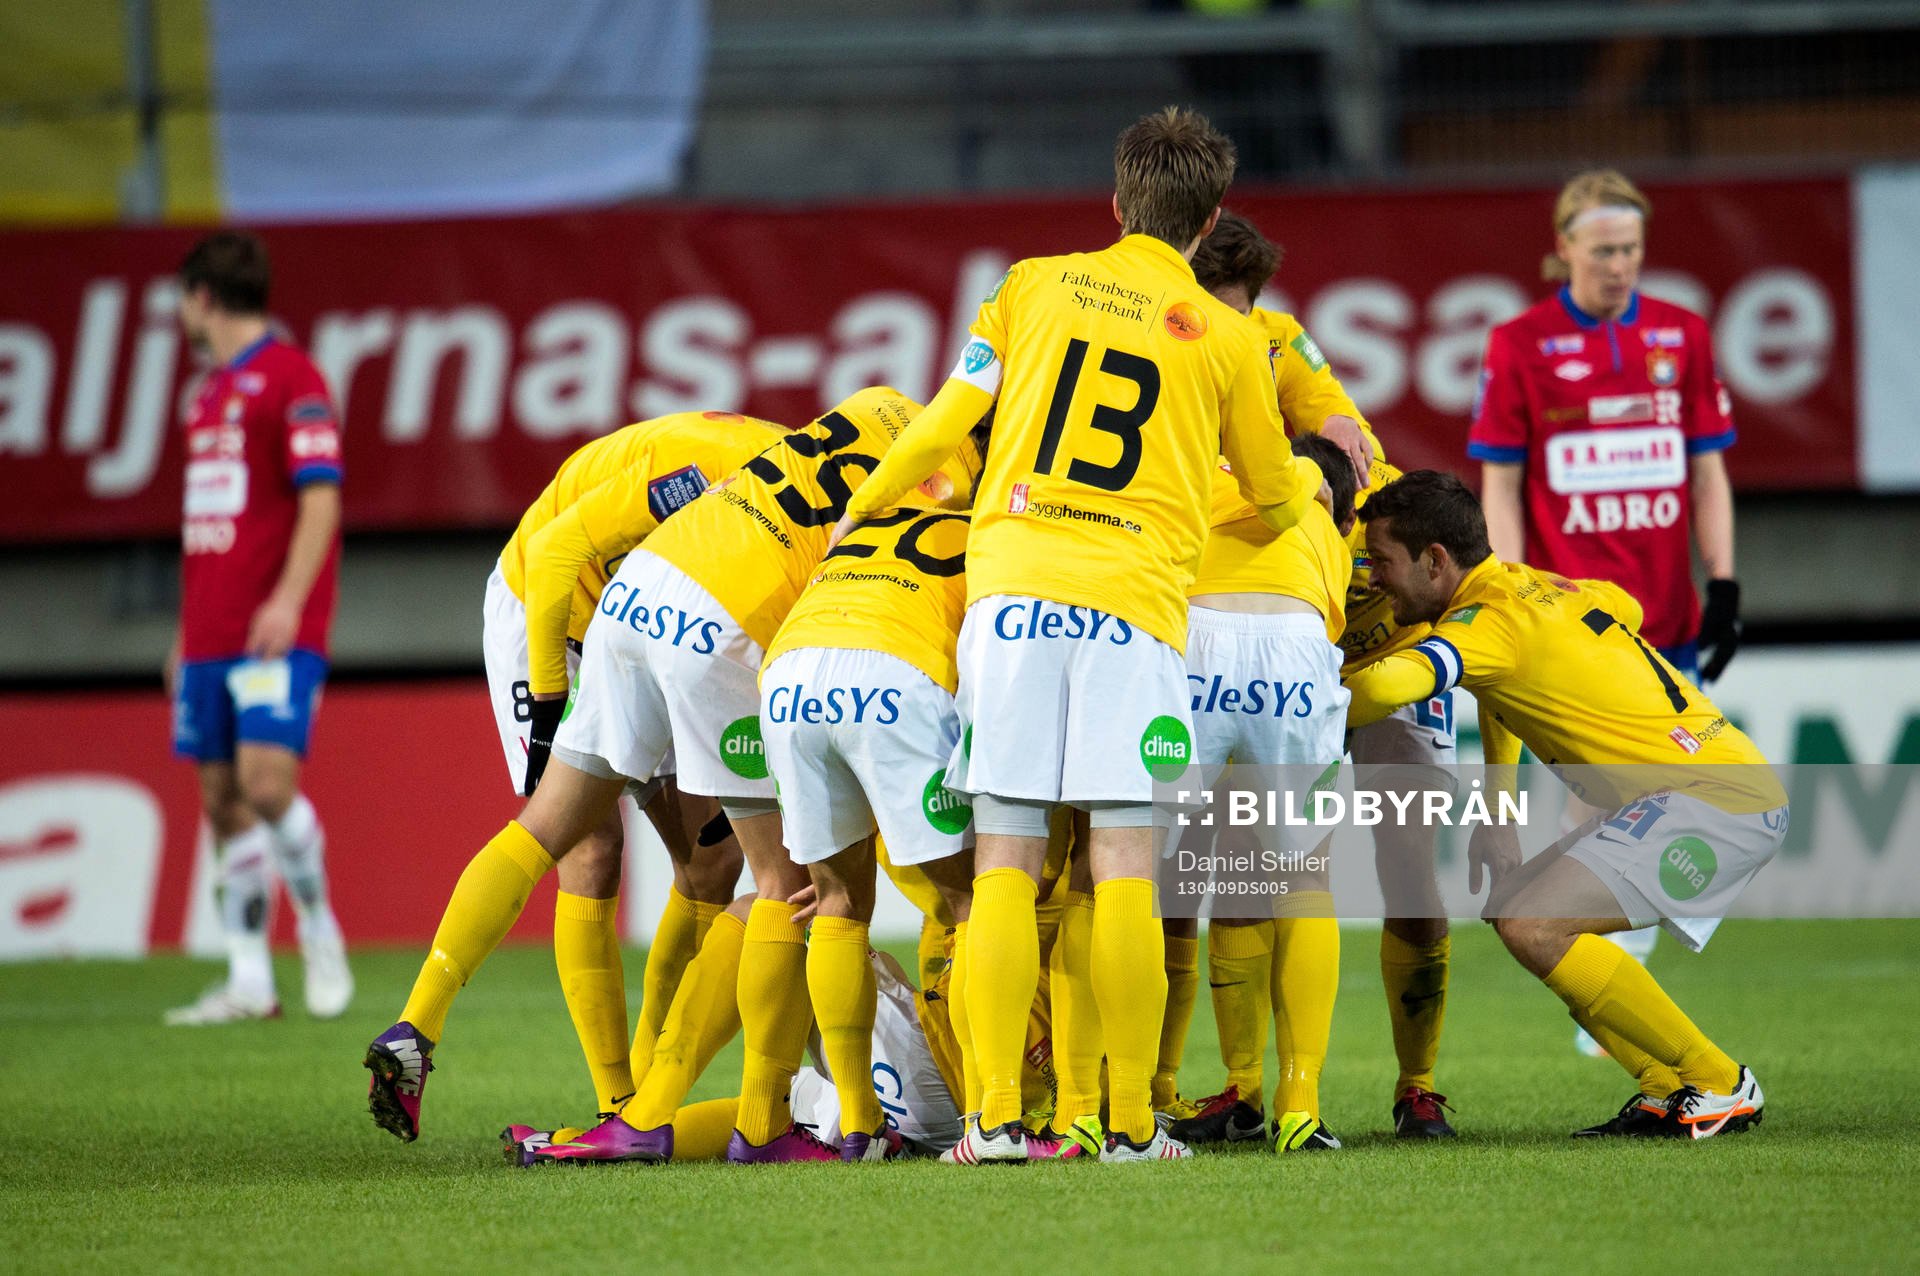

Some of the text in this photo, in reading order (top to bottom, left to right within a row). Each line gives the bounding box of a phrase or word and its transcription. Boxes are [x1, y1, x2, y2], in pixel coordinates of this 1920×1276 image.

[1061, 271, 1152, 305] Falkenbergs
[1072, 290, 1145, 322] Sparbank
[1033, 338, 1161, 492] 13
[1028, 500, 1143, 534] bygghemma.se
[601, 581, 722, 655] GleSYS
[995, 600, 1132, 646] GleSYS
[768, 684, 902, 725] GleSYS
[725, 735, 764, 757] din
[1144, 736, 1186, 759] dina
[1668, 847, 1706, 890] dina
